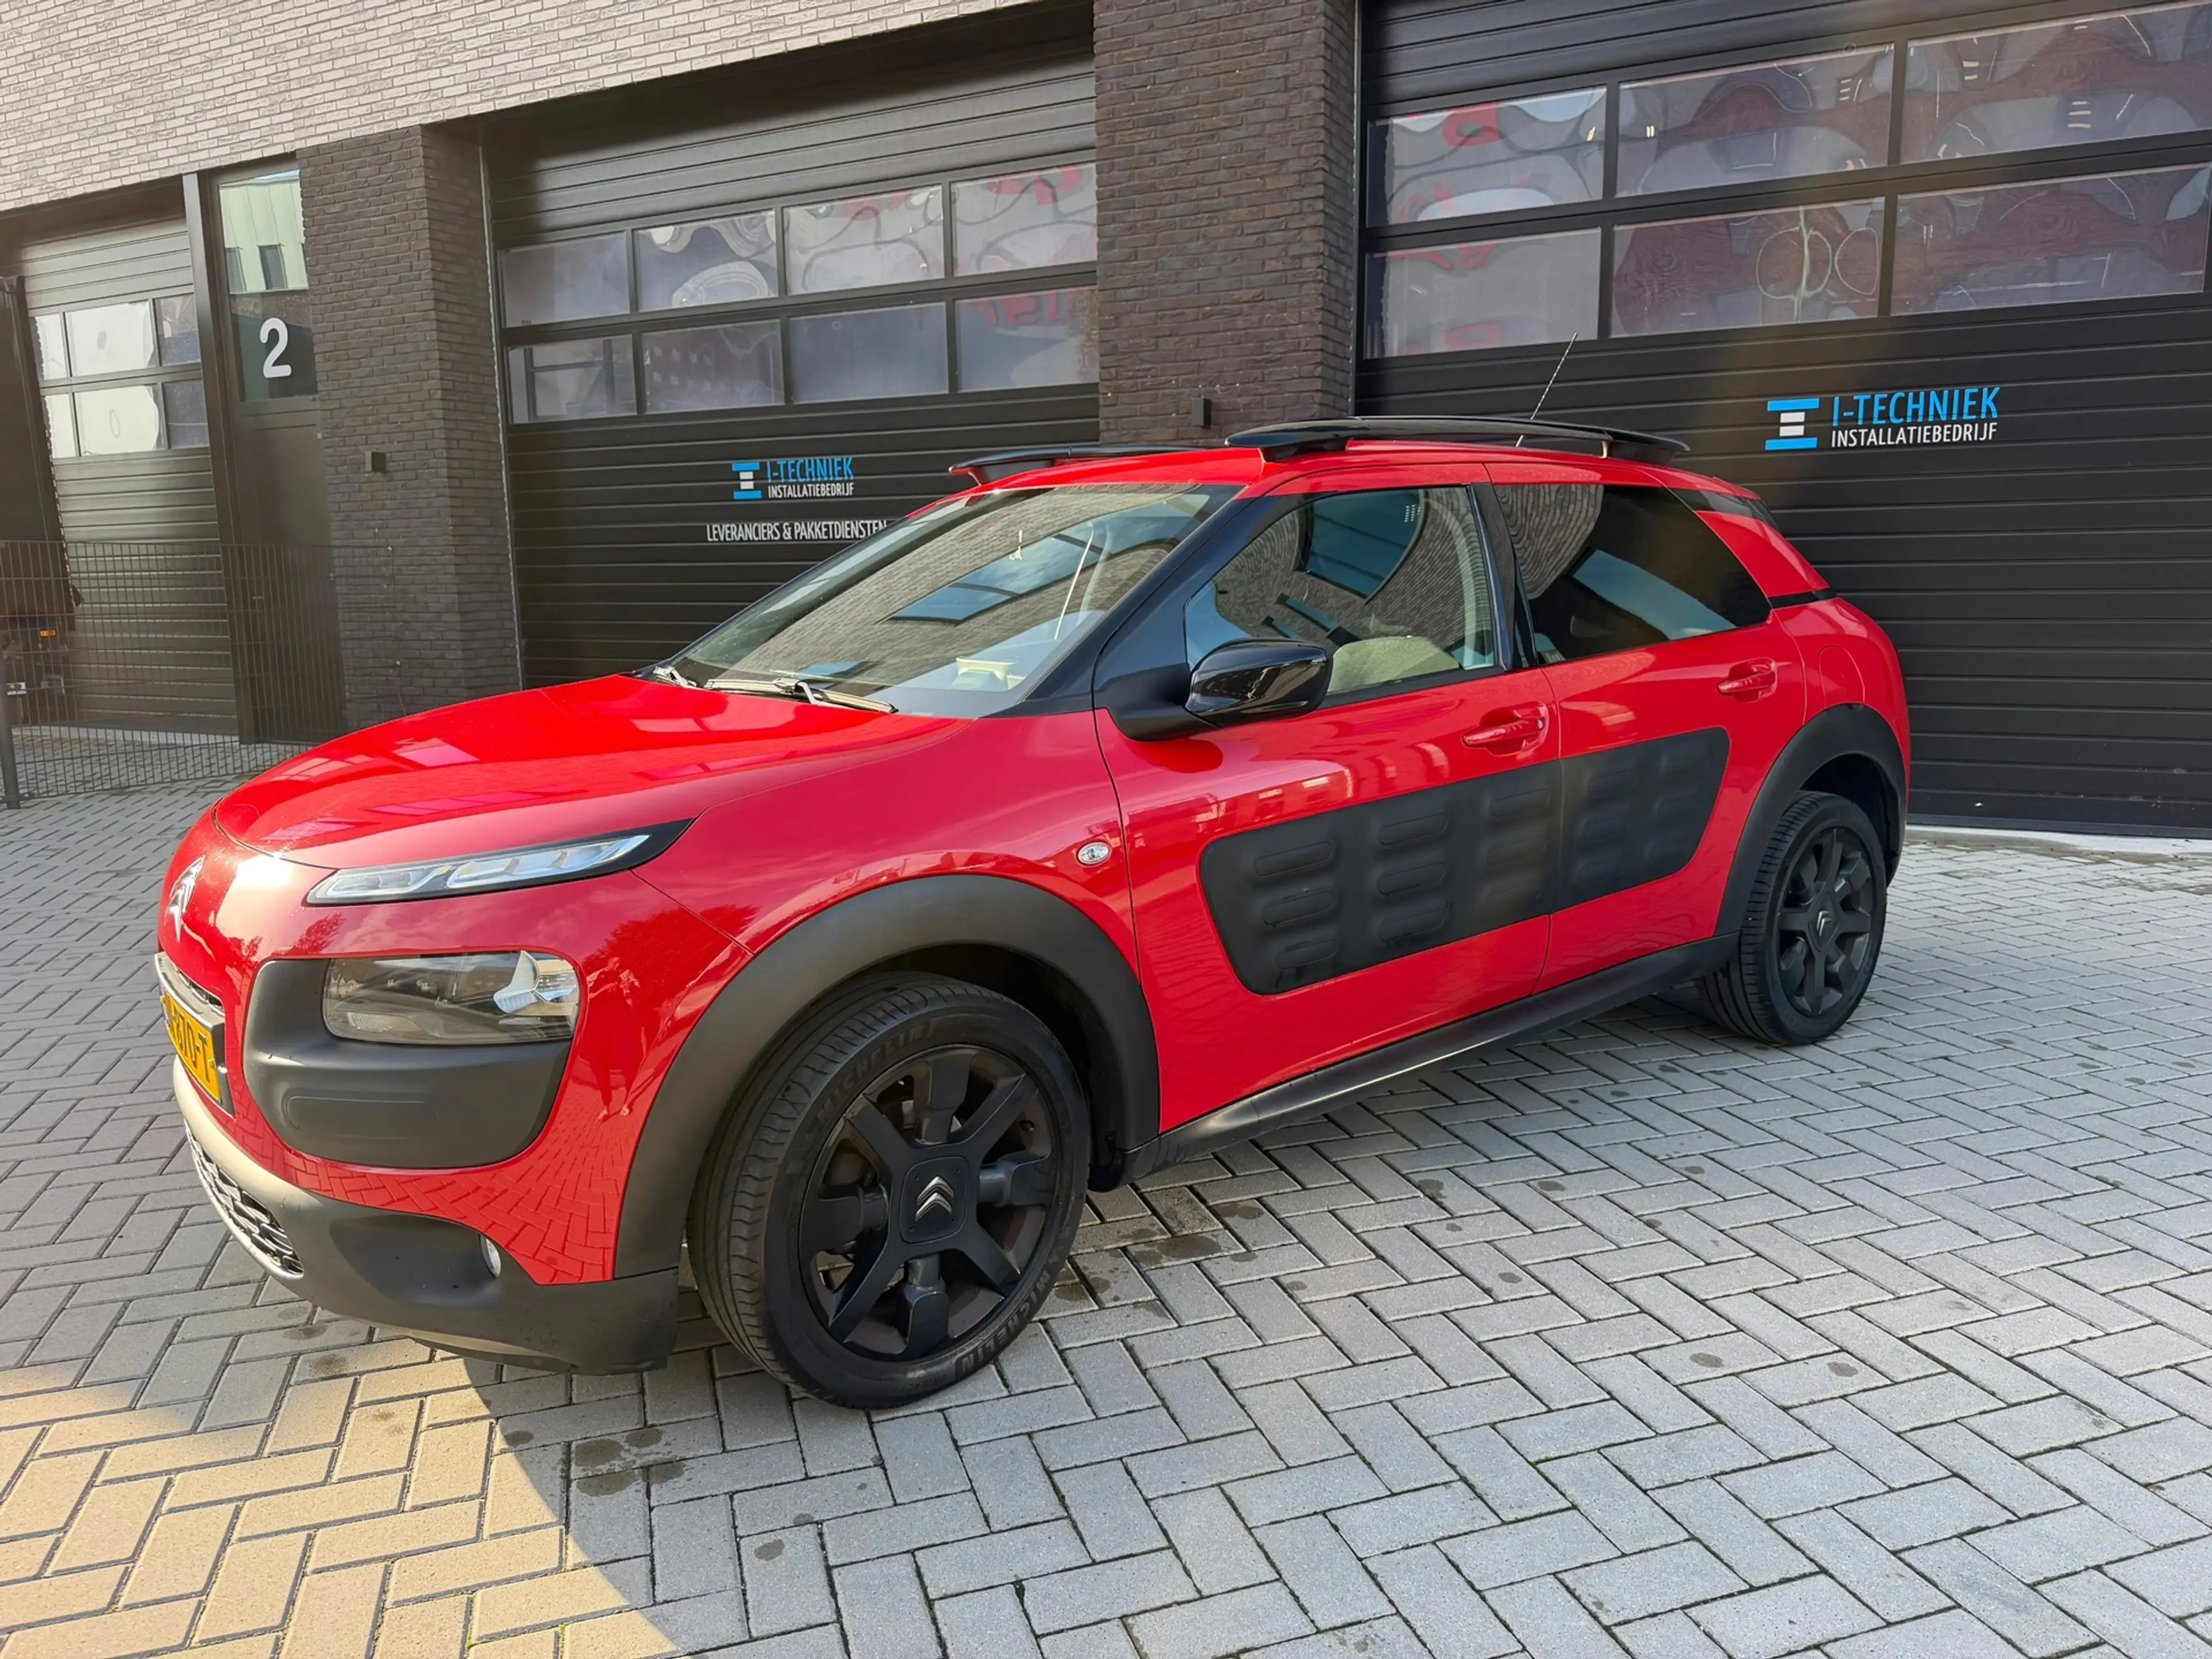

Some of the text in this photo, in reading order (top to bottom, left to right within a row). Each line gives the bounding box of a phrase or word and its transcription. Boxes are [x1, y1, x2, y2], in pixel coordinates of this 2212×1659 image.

[259, 317, 292, 378] 2
[1832, 387, 2000, 426] I-TECHNIEK
[1831, 422, 1998, 448] INSTALLATIEBEDRIJF
[767, 457, 854, 483] I-TECHNIEK
[768, 482, 855, 498] INSTALLATIEBEDRIJF
[706, 522, 781, 541] LEVERANCIERS
[782, 522, 793, 540] &
[816, 1023, 923, 1126] MICHELIN
[960, 1269, 1051, 1373] MICHELIN
